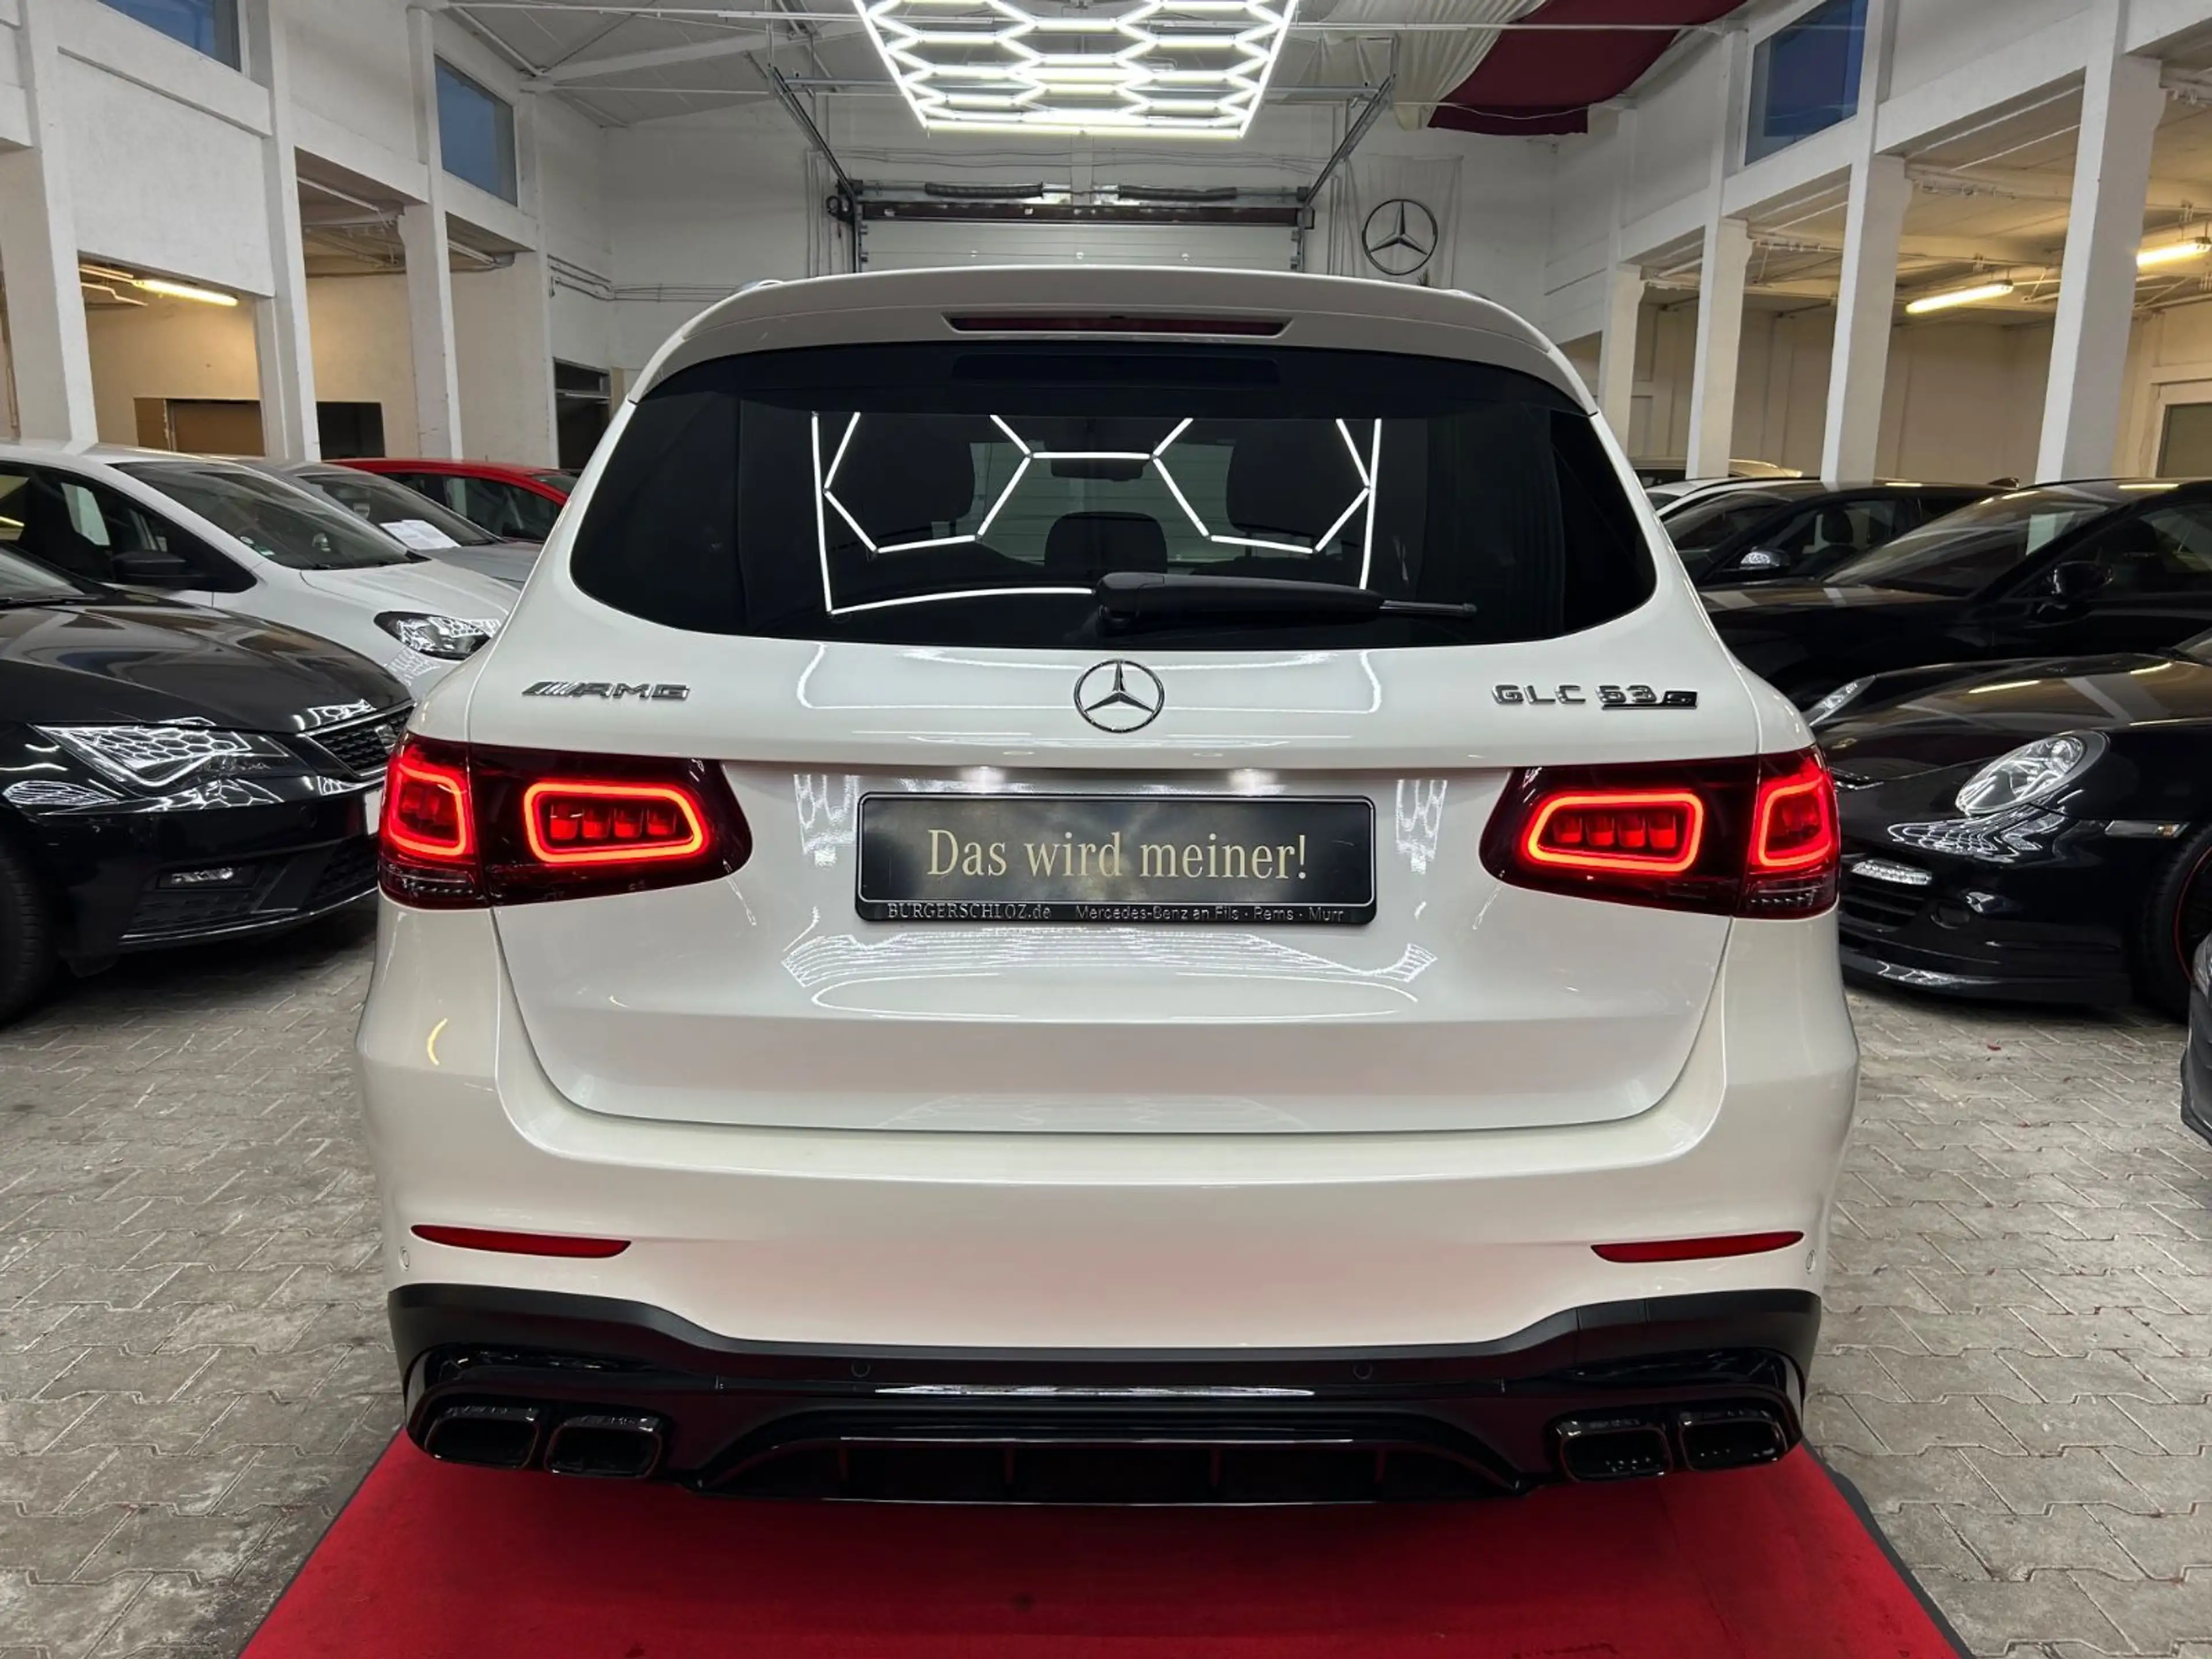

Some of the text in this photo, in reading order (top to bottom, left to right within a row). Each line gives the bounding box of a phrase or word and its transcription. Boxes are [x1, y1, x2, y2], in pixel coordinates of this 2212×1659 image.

[567, 682, 690, 700] AMG
[1492, 684, 1586, 704] GLC
[926, 829, 1306, 880] Das wird meiner!
[887, 903, 1344, 922] BURGERSCHLOZ.de Mercedes-Benz an Fils Rems Murr
